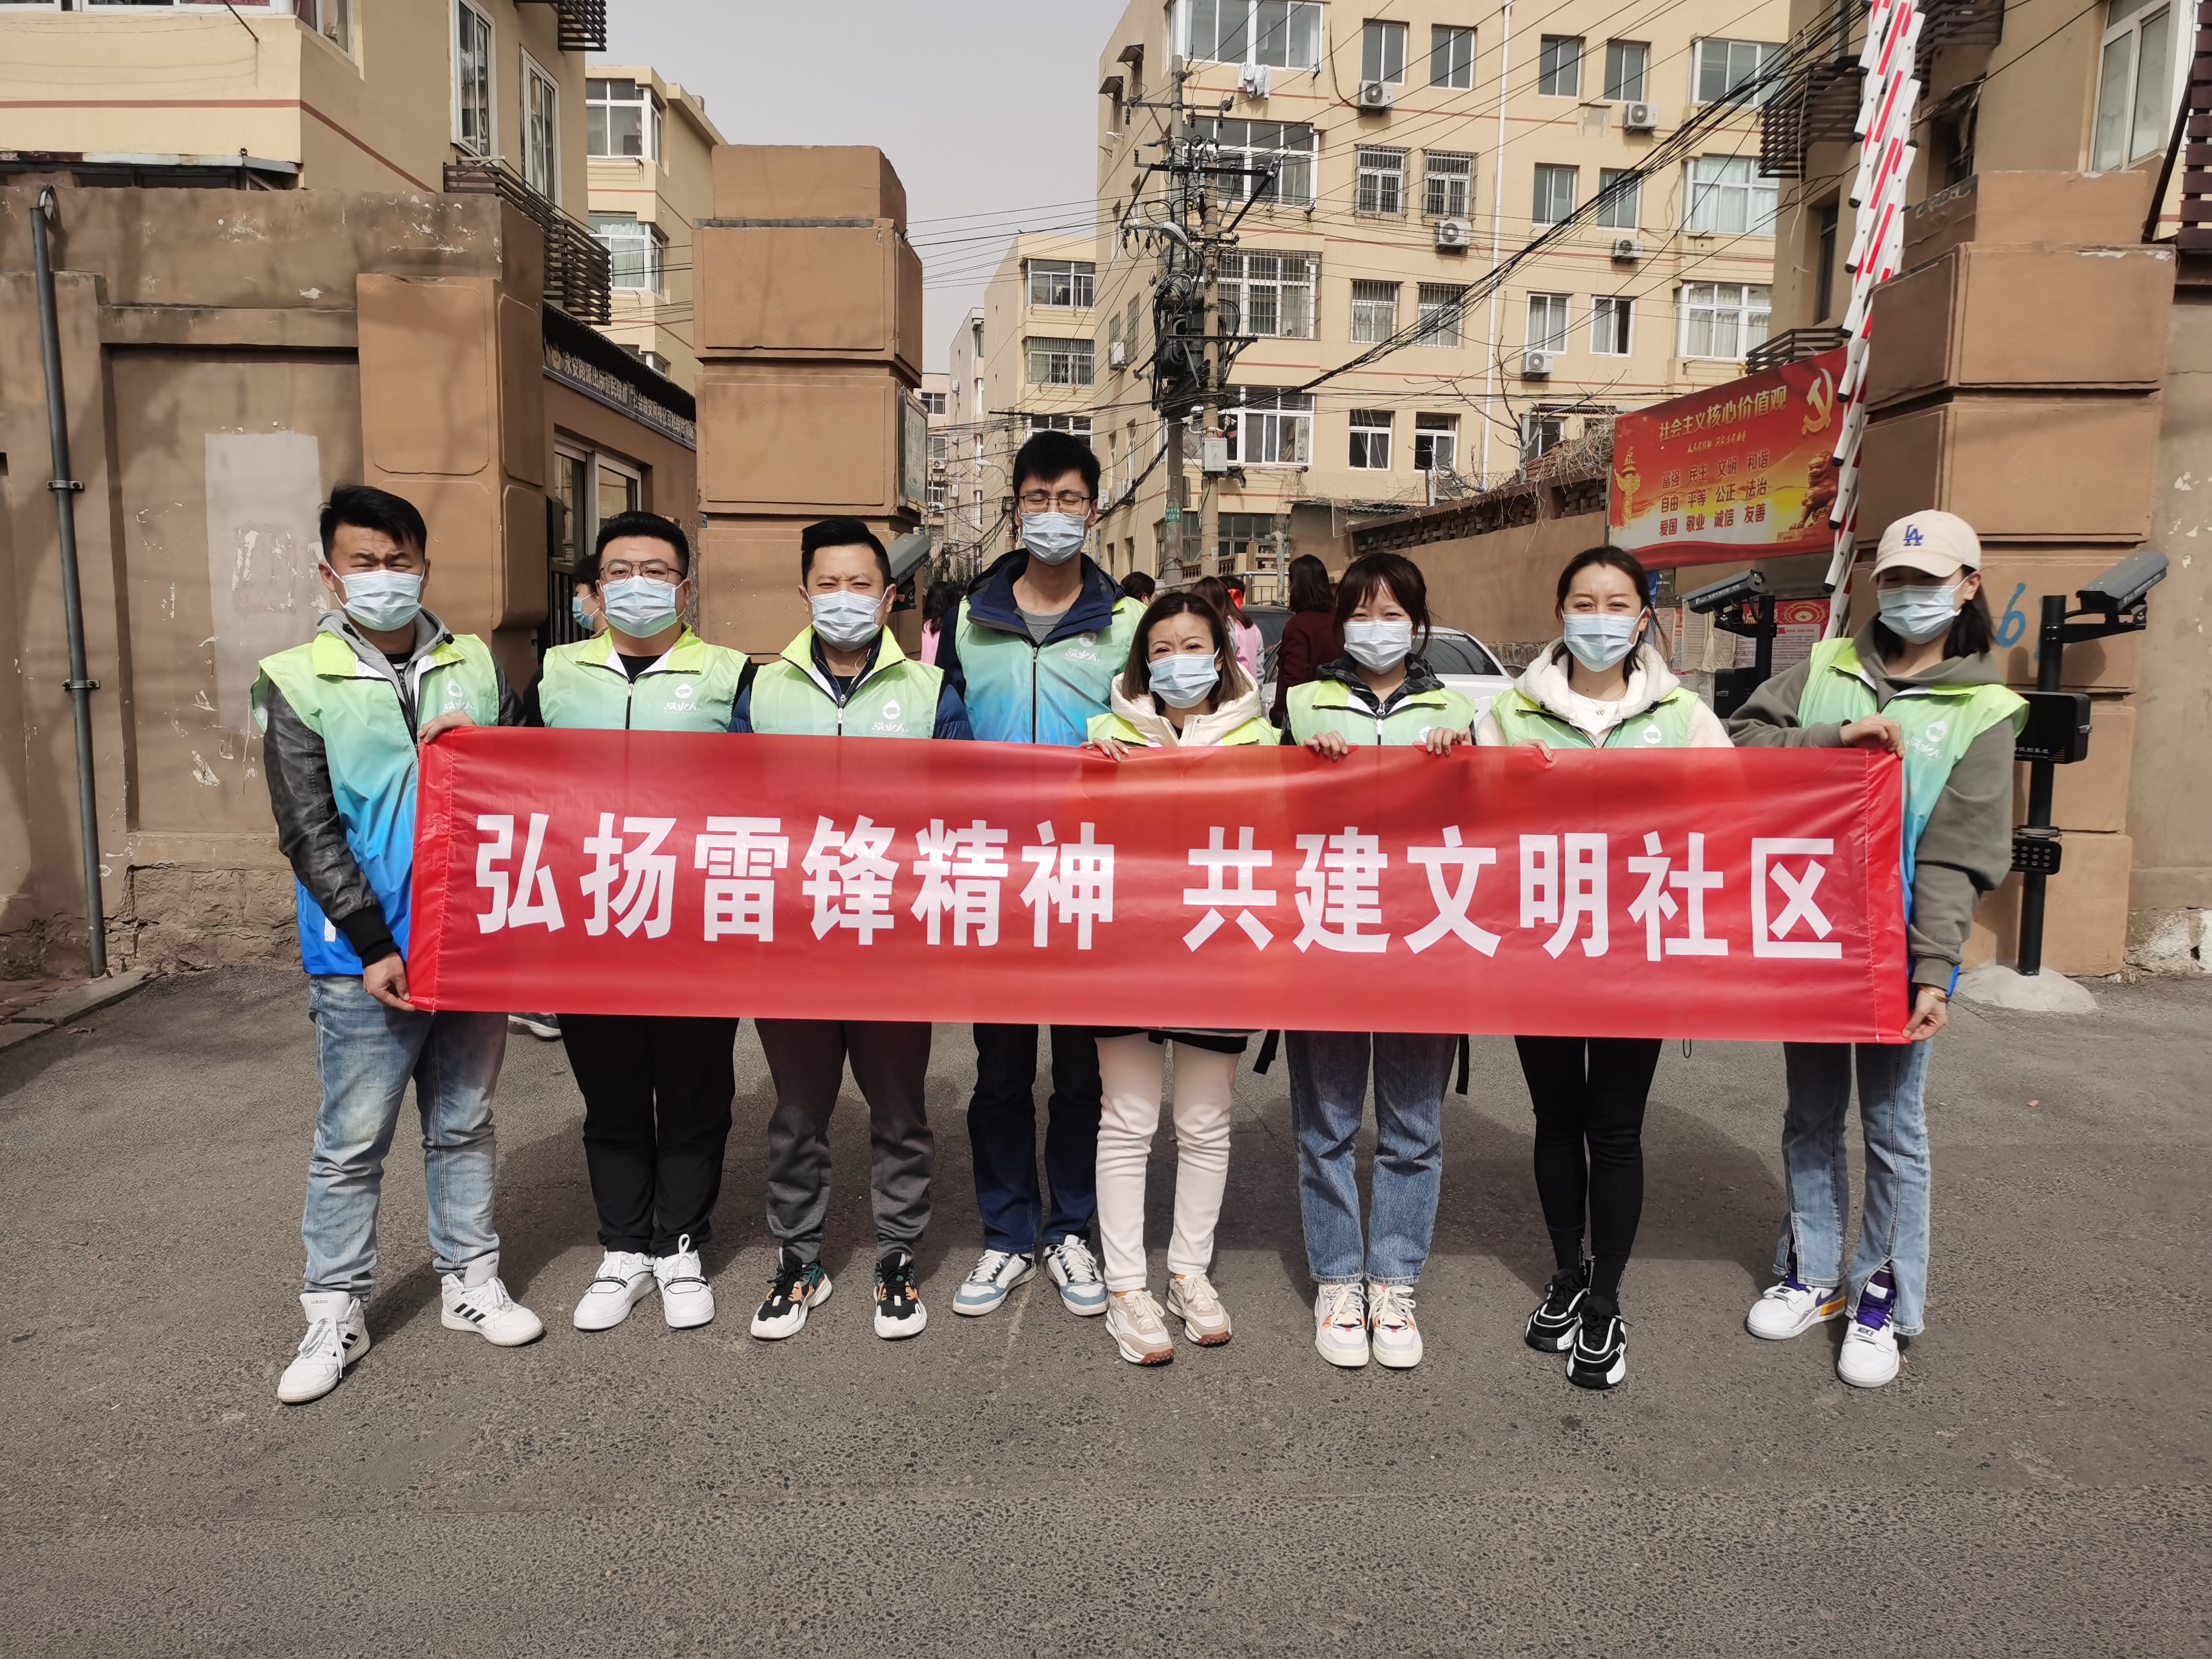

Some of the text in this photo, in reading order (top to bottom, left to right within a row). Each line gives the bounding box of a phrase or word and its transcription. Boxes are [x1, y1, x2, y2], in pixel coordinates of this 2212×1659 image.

[1659, 385, 1787, 442] 社会主义核心价值观
[1662, 450, 1769, 489] 富强 民主 文明 和谐
[1661, 477, 1768, 514] 自由 平等 公正 法治
[1660, 503, 1766, 537] 爱国 敬业 诚信 友善
[1903, 524, 1923, 546] LA
[475, 812, 1843, 962] 弘扬雷锋精神 共建文明社区
